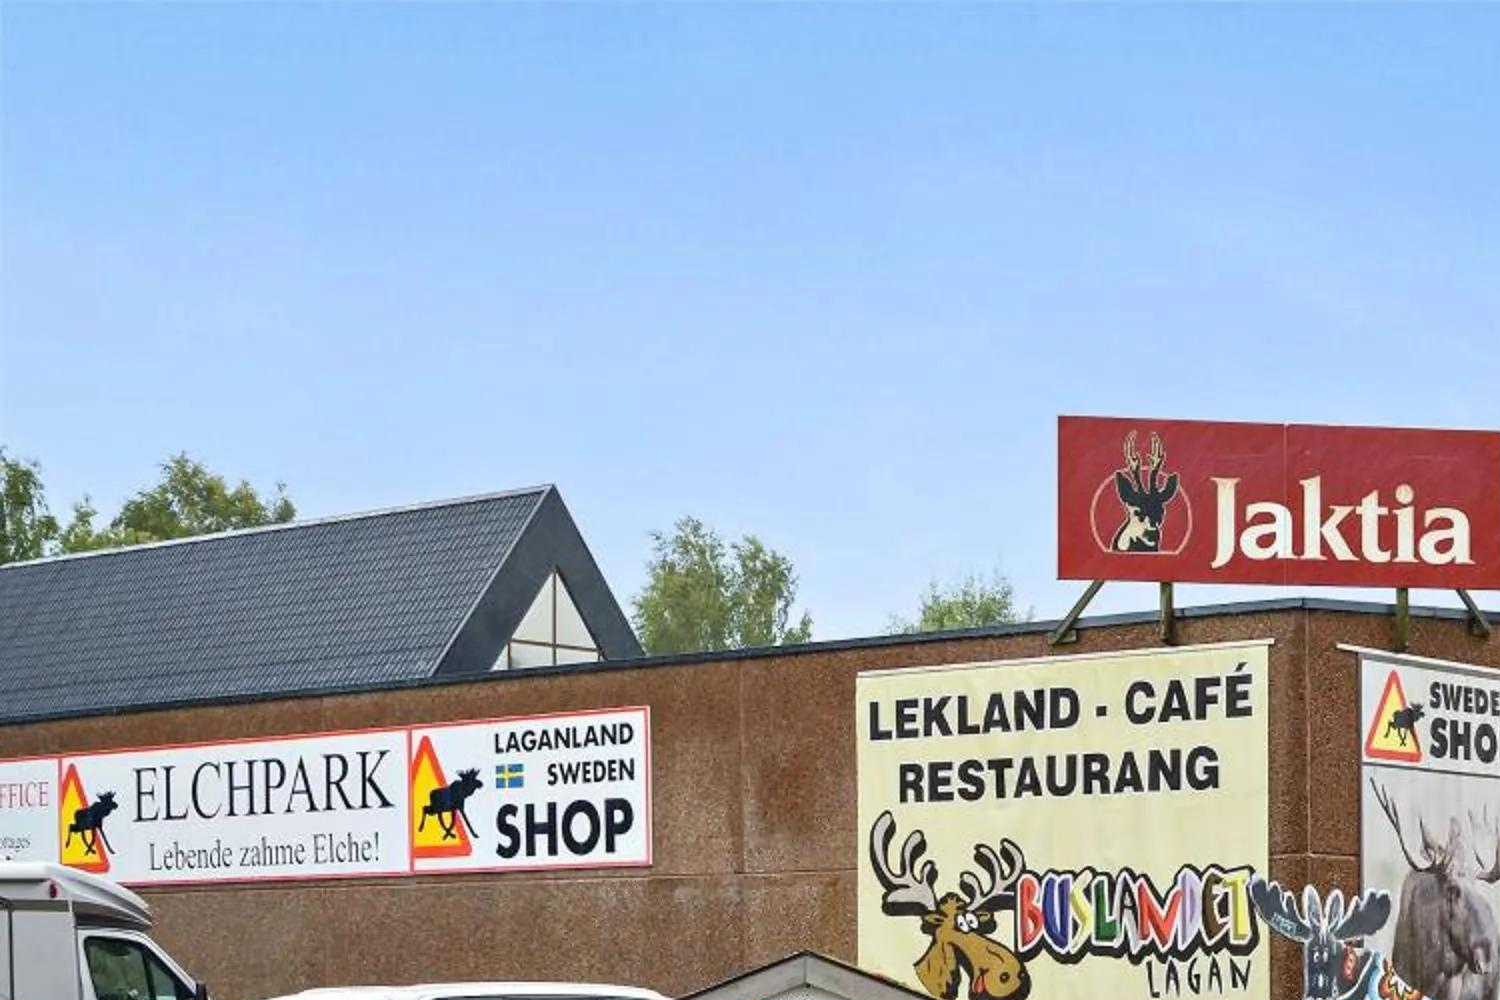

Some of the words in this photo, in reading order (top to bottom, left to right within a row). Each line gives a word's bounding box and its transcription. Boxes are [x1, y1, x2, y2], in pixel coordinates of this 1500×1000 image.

[1210, 476, 1475, 569] Jaktia
[869, 688, 1080, 741] LEKLAND
[1125, 662, 1254, 724] CAFÉ
[494, 722, 635, 754] LAGANLAND
[133, 749, 394, 824] ELCHPARK
[547, 758, 636, 785] SWEDEN
[899, 745, 1219, 803] RESTAURANG
[149, 833, 233, 872] Lebende
[239, 838, 305, 866] zahme
[313, 830, 380, 864] Elche!
[495, 797, 635, 860] SHOP
[1016, 866, 1252, 954] BUSLANDET
[1147, 956, 1250, 998] LAGAN
